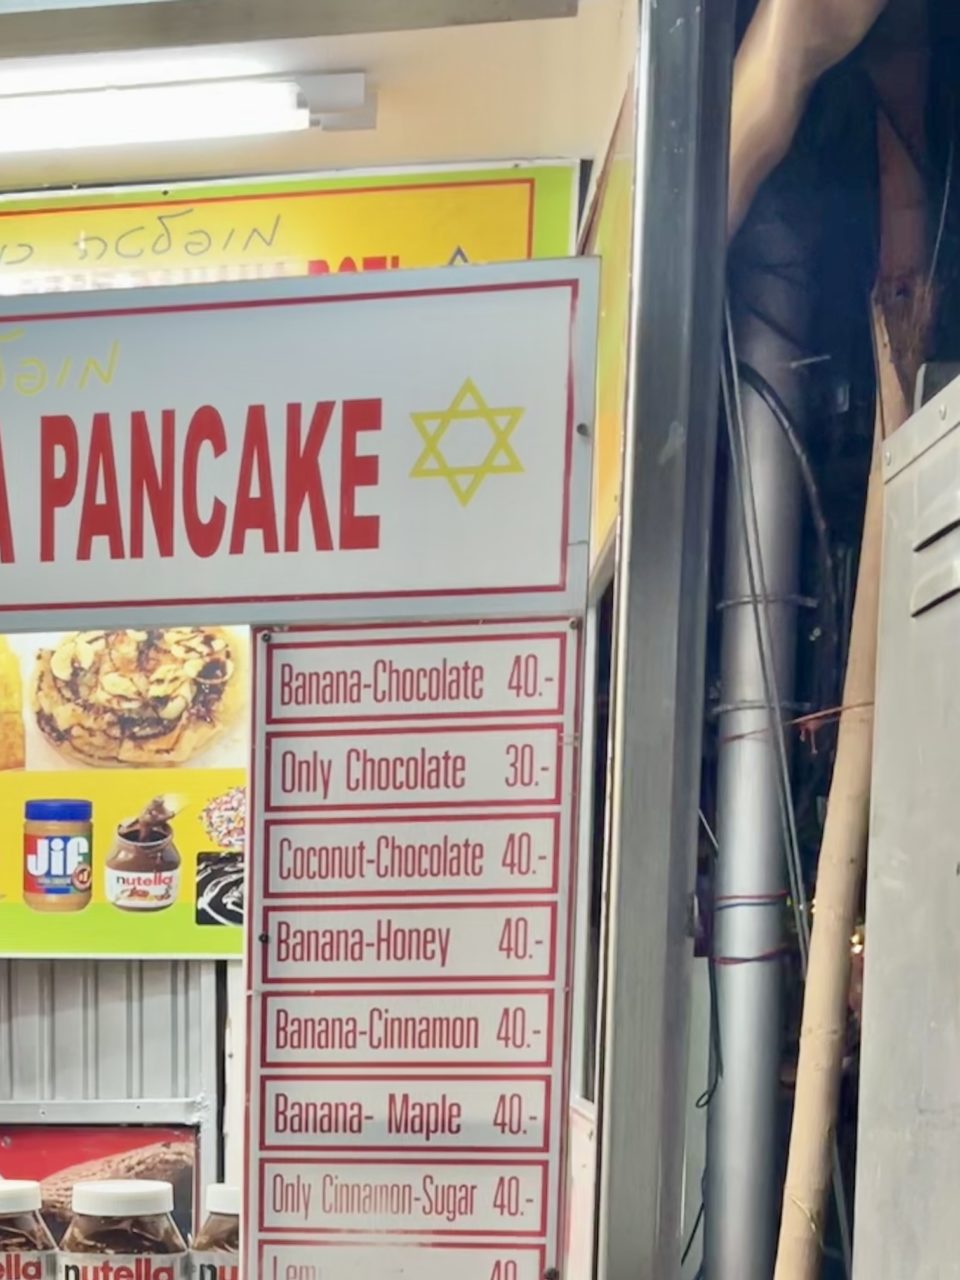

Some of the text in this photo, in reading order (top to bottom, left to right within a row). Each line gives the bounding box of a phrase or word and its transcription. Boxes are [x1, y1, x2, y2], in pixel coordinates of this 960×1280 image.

[39, 396, 384, 563] PANCAKE
[280, 654, 554, 706] Banana-Chocolate 40.-
[281, 744, 549, 800] Only Chocolate 30.-
[116, 870, 174, 887] nutella
[279, 832, 547, 880] Coconut-Chocolate 40.-
[276, 917, 543, 968] Banana-Honey 40.-
[276, 1006, 541, 1050] Banana-Cinnamon 40.-
[388, 1093, 462, 1141] Maple
[493, 1093, 538, 1135] 40.-
[272, 1173, 311, 1221] Only
[493, 1175, 534, 1217] 40.-
